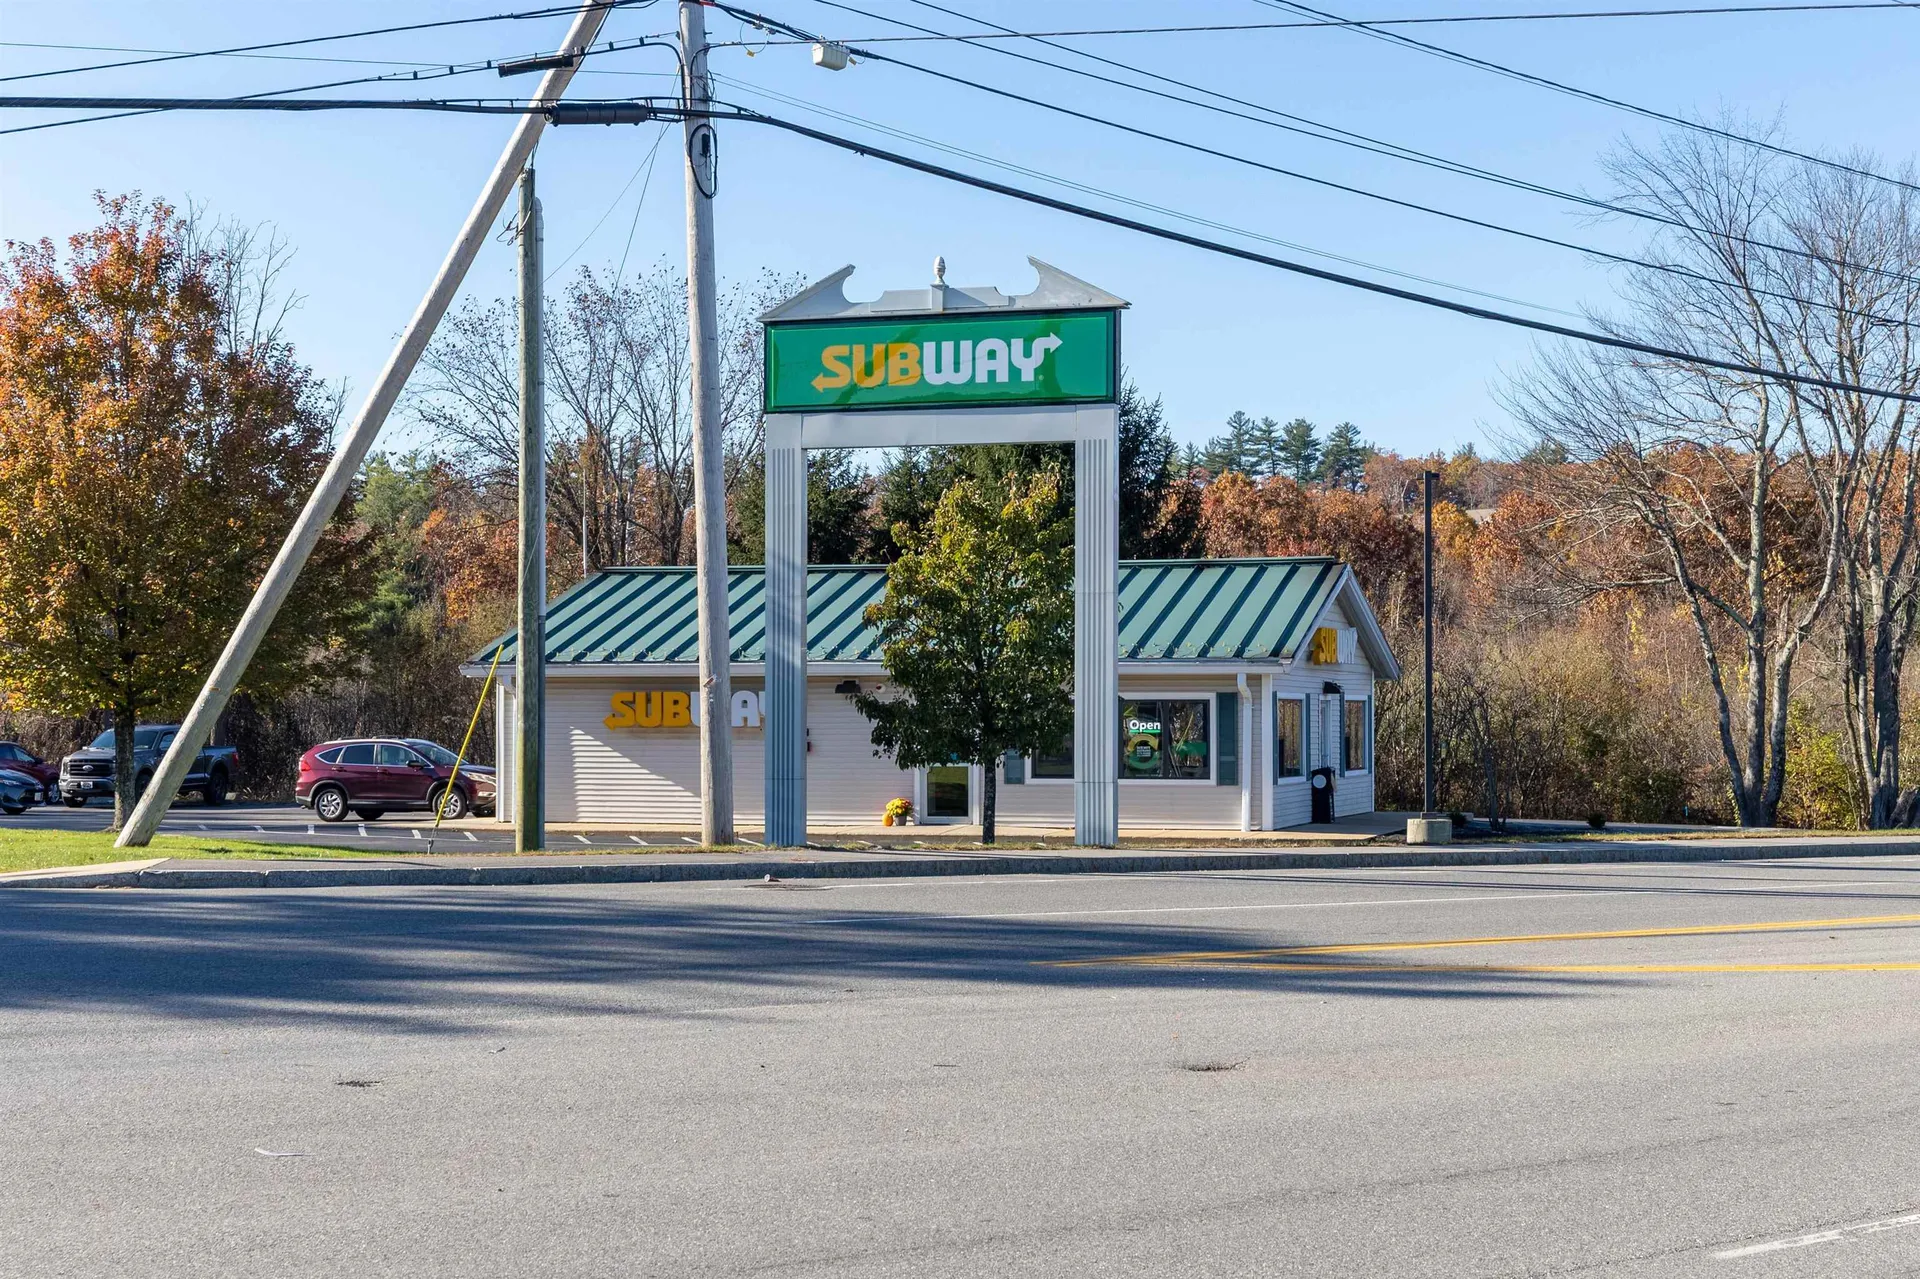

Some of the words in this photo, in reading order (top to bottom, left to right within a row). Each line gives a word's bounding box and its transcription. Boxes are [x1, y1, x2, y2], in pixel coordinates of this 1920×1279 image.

[811, 332, 1063, 393] SUBWAY
[603, 690, 765, 731] SUBA
[1129, 720, 1161, 733] Open
